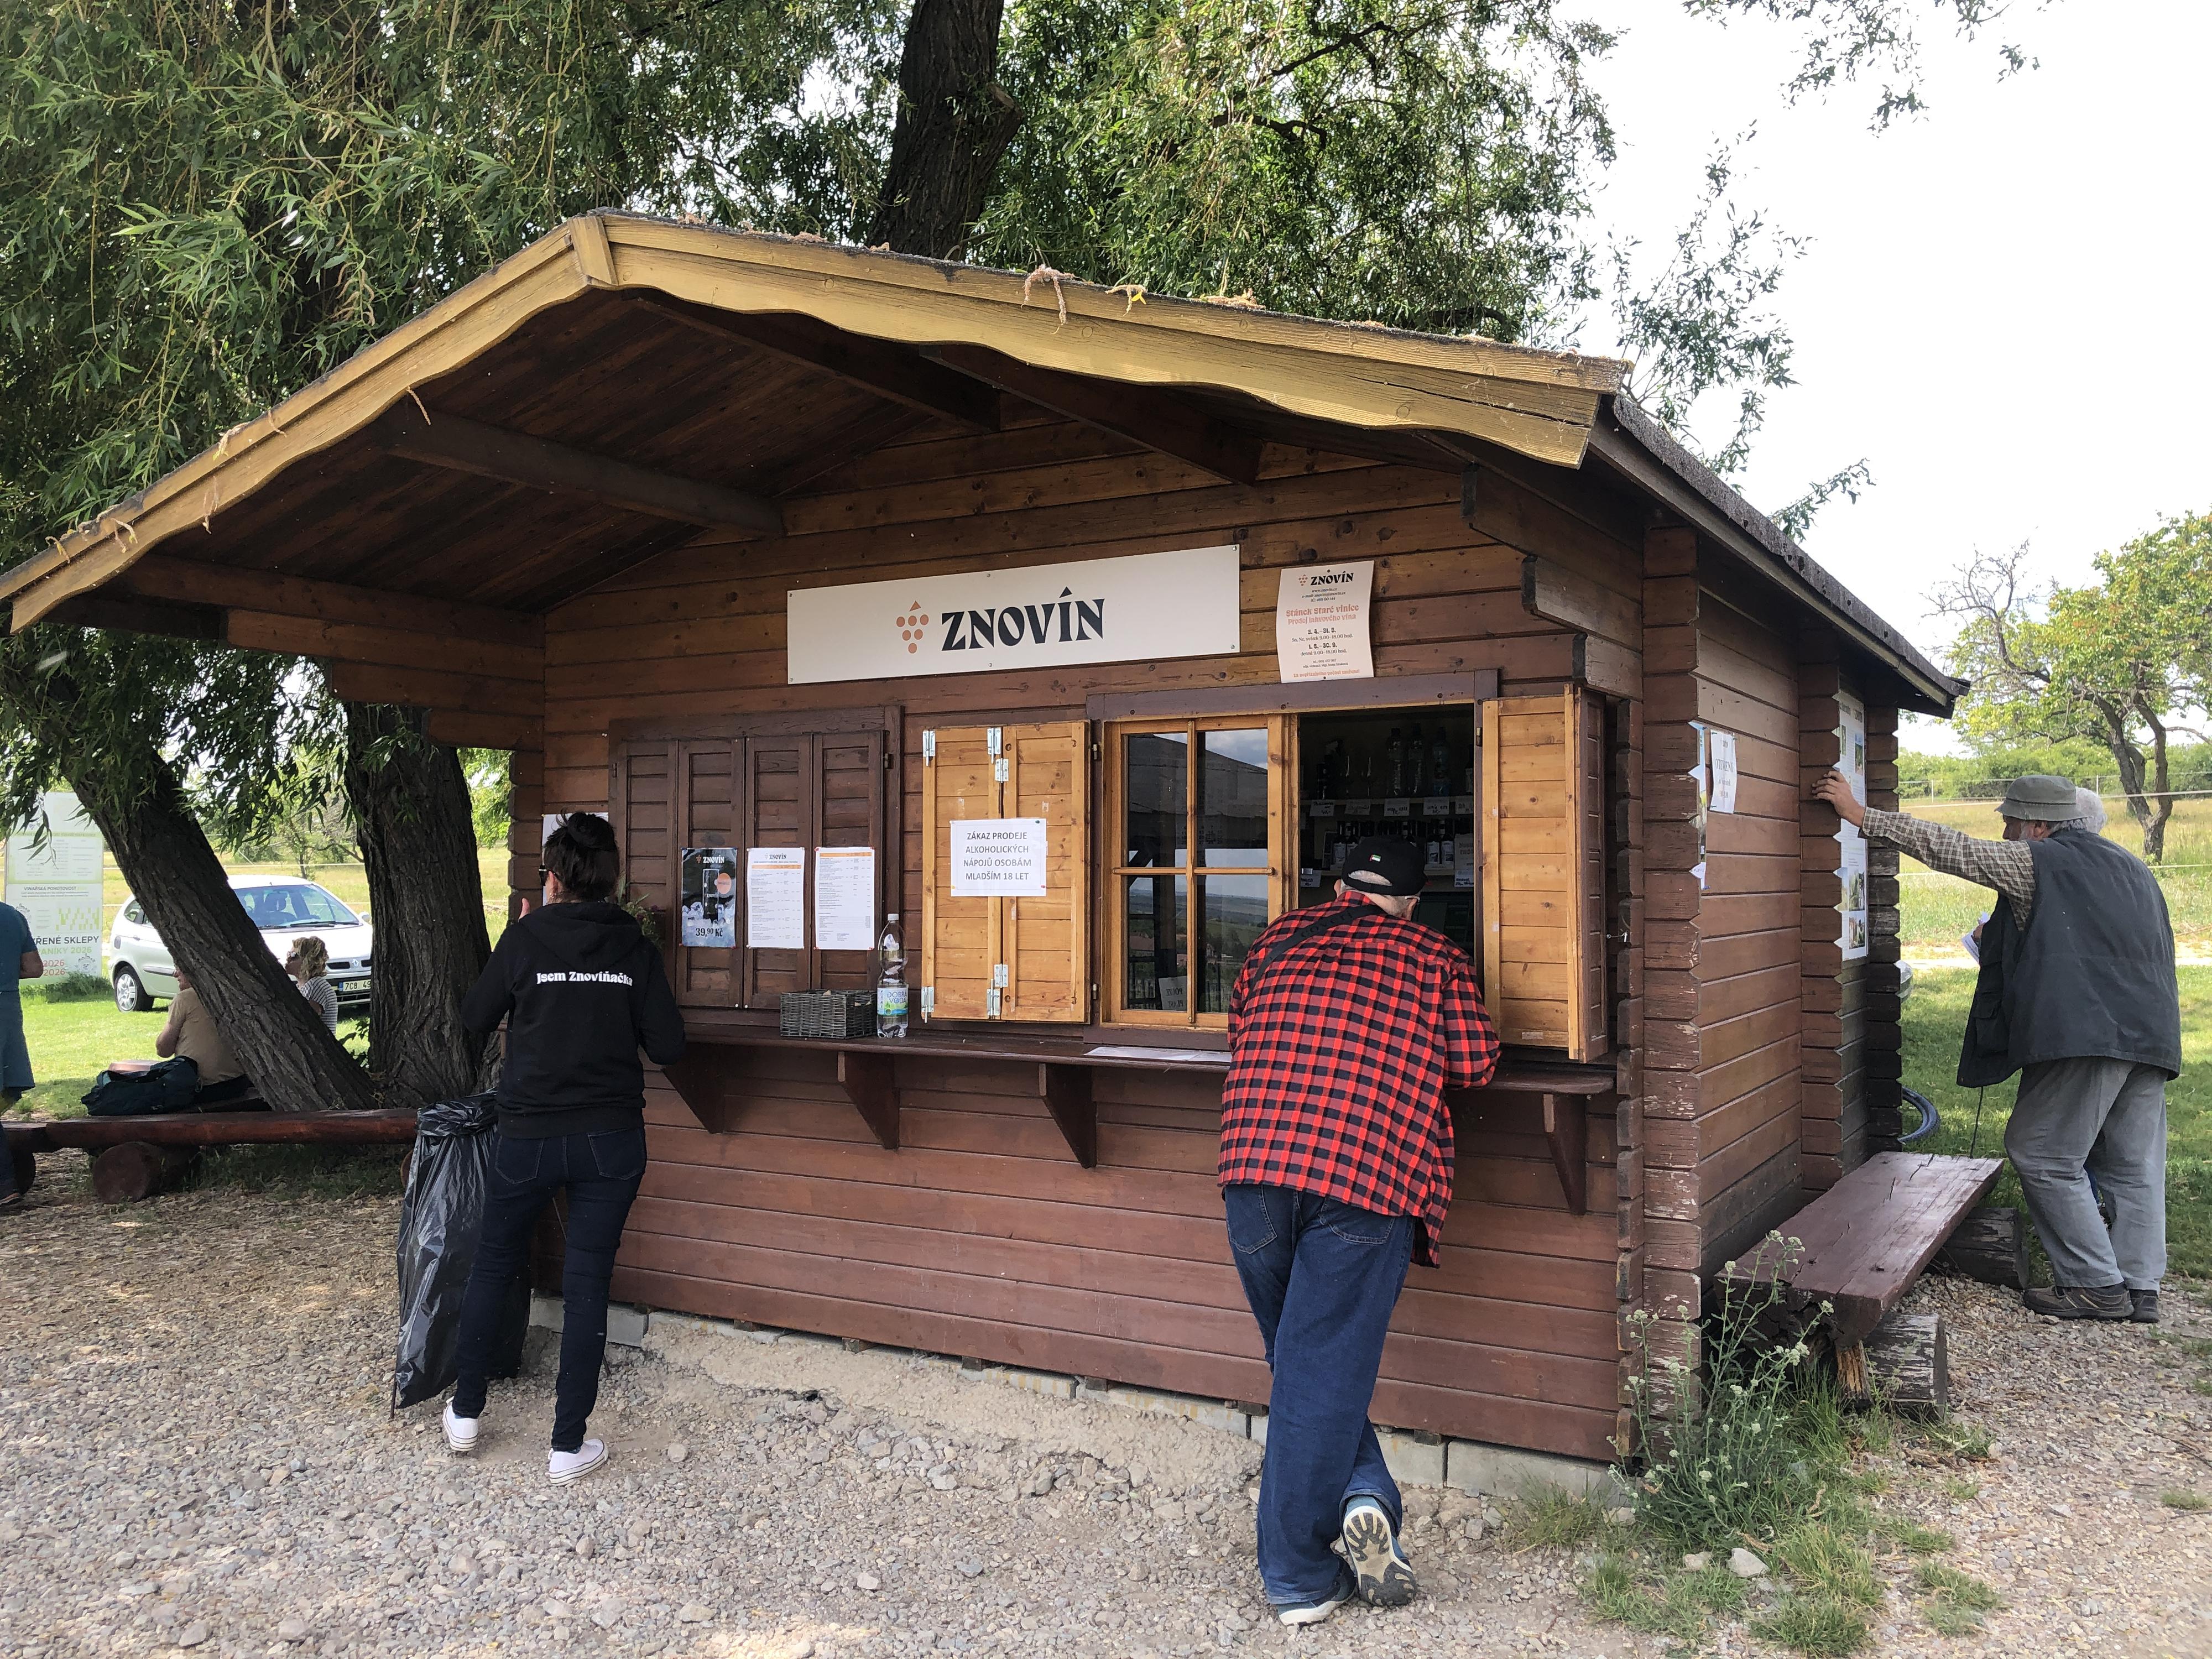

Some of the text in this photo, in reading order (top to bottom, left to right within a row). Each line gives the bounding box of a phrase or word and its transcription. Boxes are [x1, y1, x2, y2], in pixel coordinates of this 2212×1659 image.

[1310, 570, 1354, 586] ZNOVÍN
[1286, 604, 1359, 617] Stánek Staré vinice
[941, 586, 1105, 651] ZNOVÍN
[1288, 617, 1308, 625] Prodej
[1309, 614, 1340, 623] lahvového
[967, 831, 990, 840] ZÁKAZ
[966, 844, 1029, 853] ALKOHOLICKÝCH
[703, 855, 725, 864] ZNOVÍN
[963, 857, 1031, 867] NÁPOJŮ OSOBÁM
[966, 871, 1001, 880] MLADŠÍM
[695, 927, 723, 937] 39,90 Kč
[33, 935, 100, 945] ŘENÉ SKLEPY
[39, 947, 68, 955] ANÍKY
[536, 971, 633, 986] Jsem Znovíňačka
[345, 982, 358, 990] 7C8
